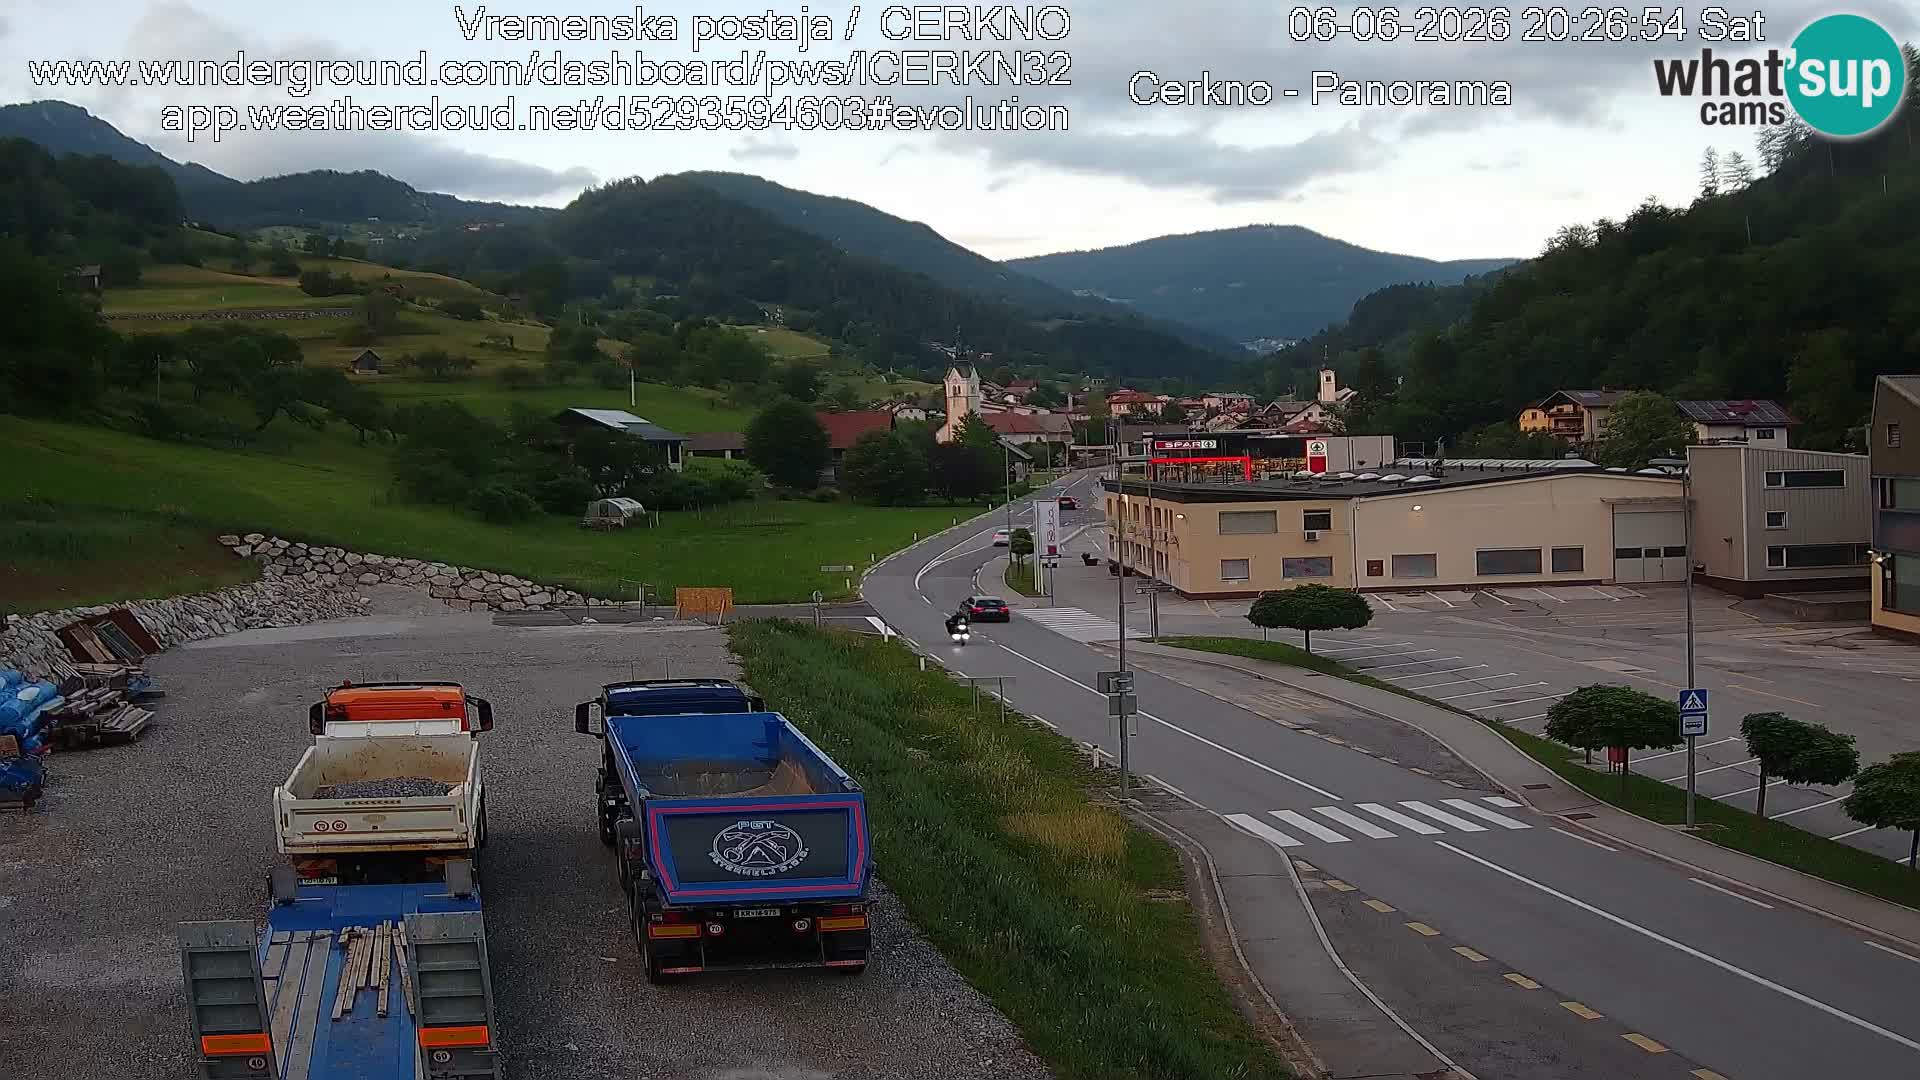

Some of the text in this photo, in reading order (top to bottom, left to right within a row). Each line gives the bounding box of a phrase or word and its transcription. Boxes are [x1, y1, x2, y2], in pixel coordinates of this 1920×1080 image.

[1164, 441, 1201, 449] SPAR
[435, 1050, 449, 1063] 60
[251, 1057, 264, 1069] 40
